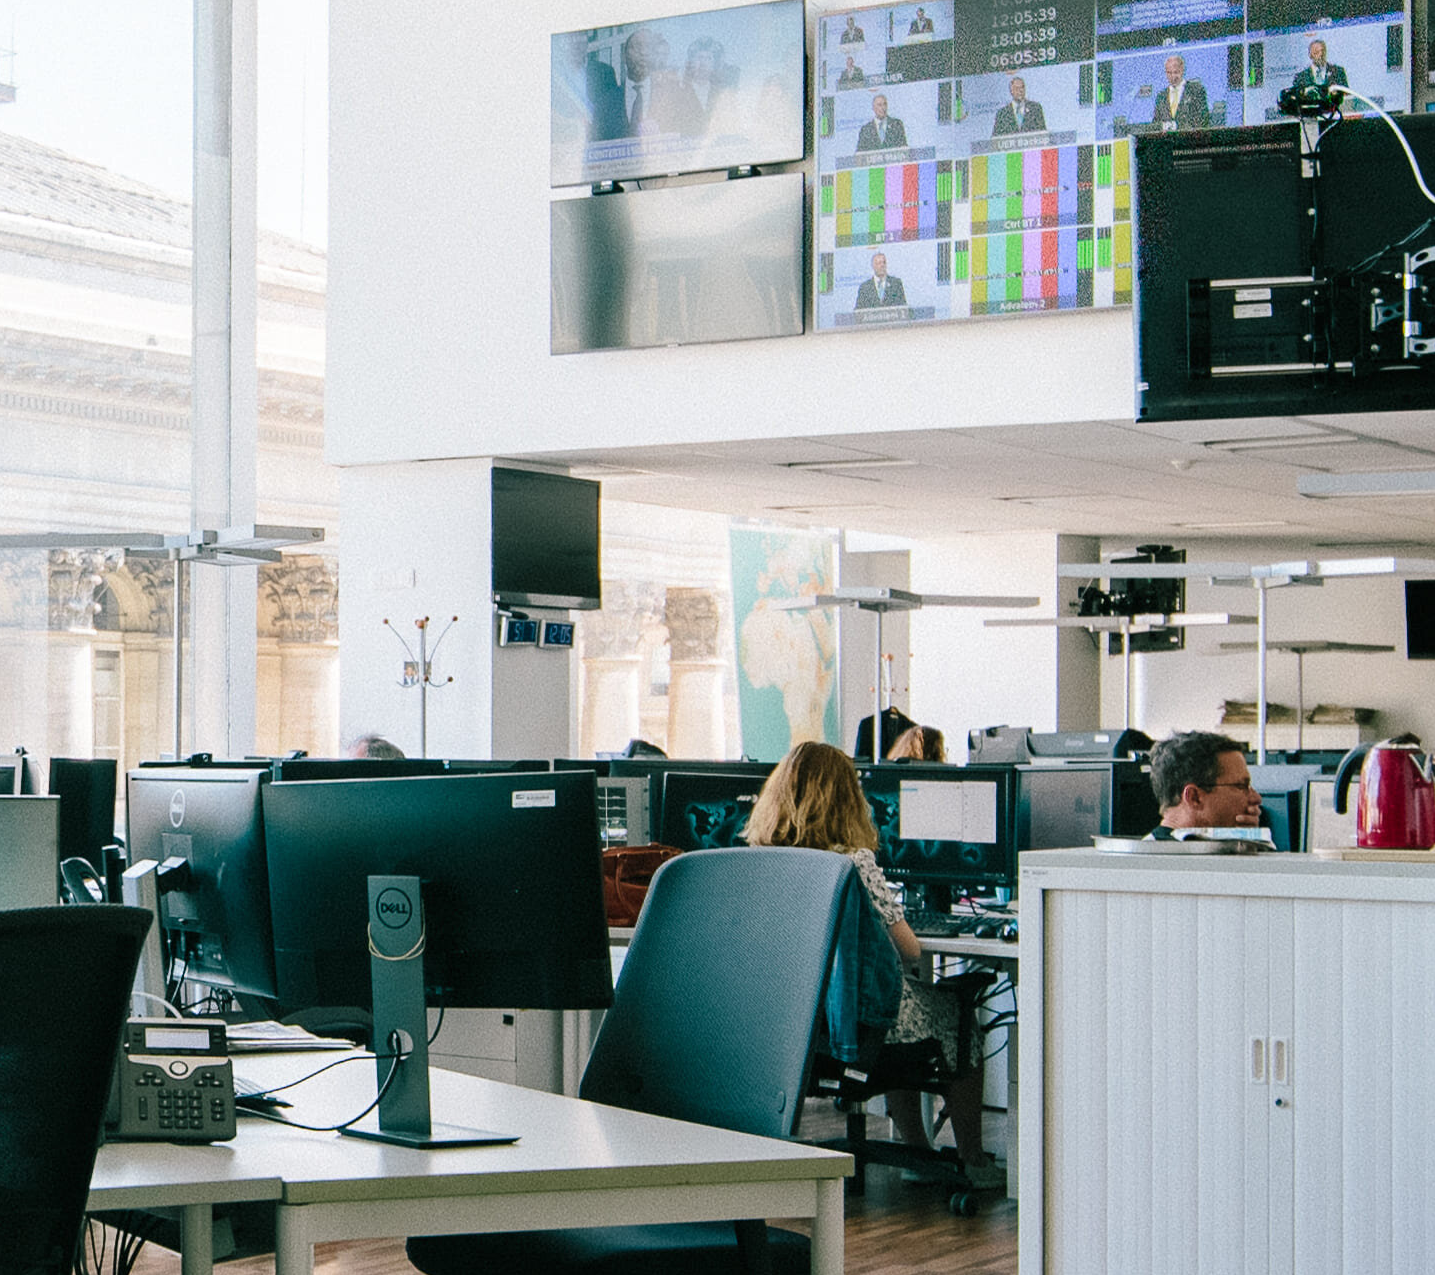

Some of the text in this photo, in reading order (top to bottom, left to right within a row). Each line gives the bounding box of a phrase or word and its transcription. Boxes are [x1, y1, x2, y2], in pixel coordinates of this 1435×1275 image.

[992, 6, 1057, 28] 12:05:39
[991, 26, 1057, 48] 18:05:39
[990, 46, 1057, 68] 06:05:39
[380, 902, 408, 914] DELL
